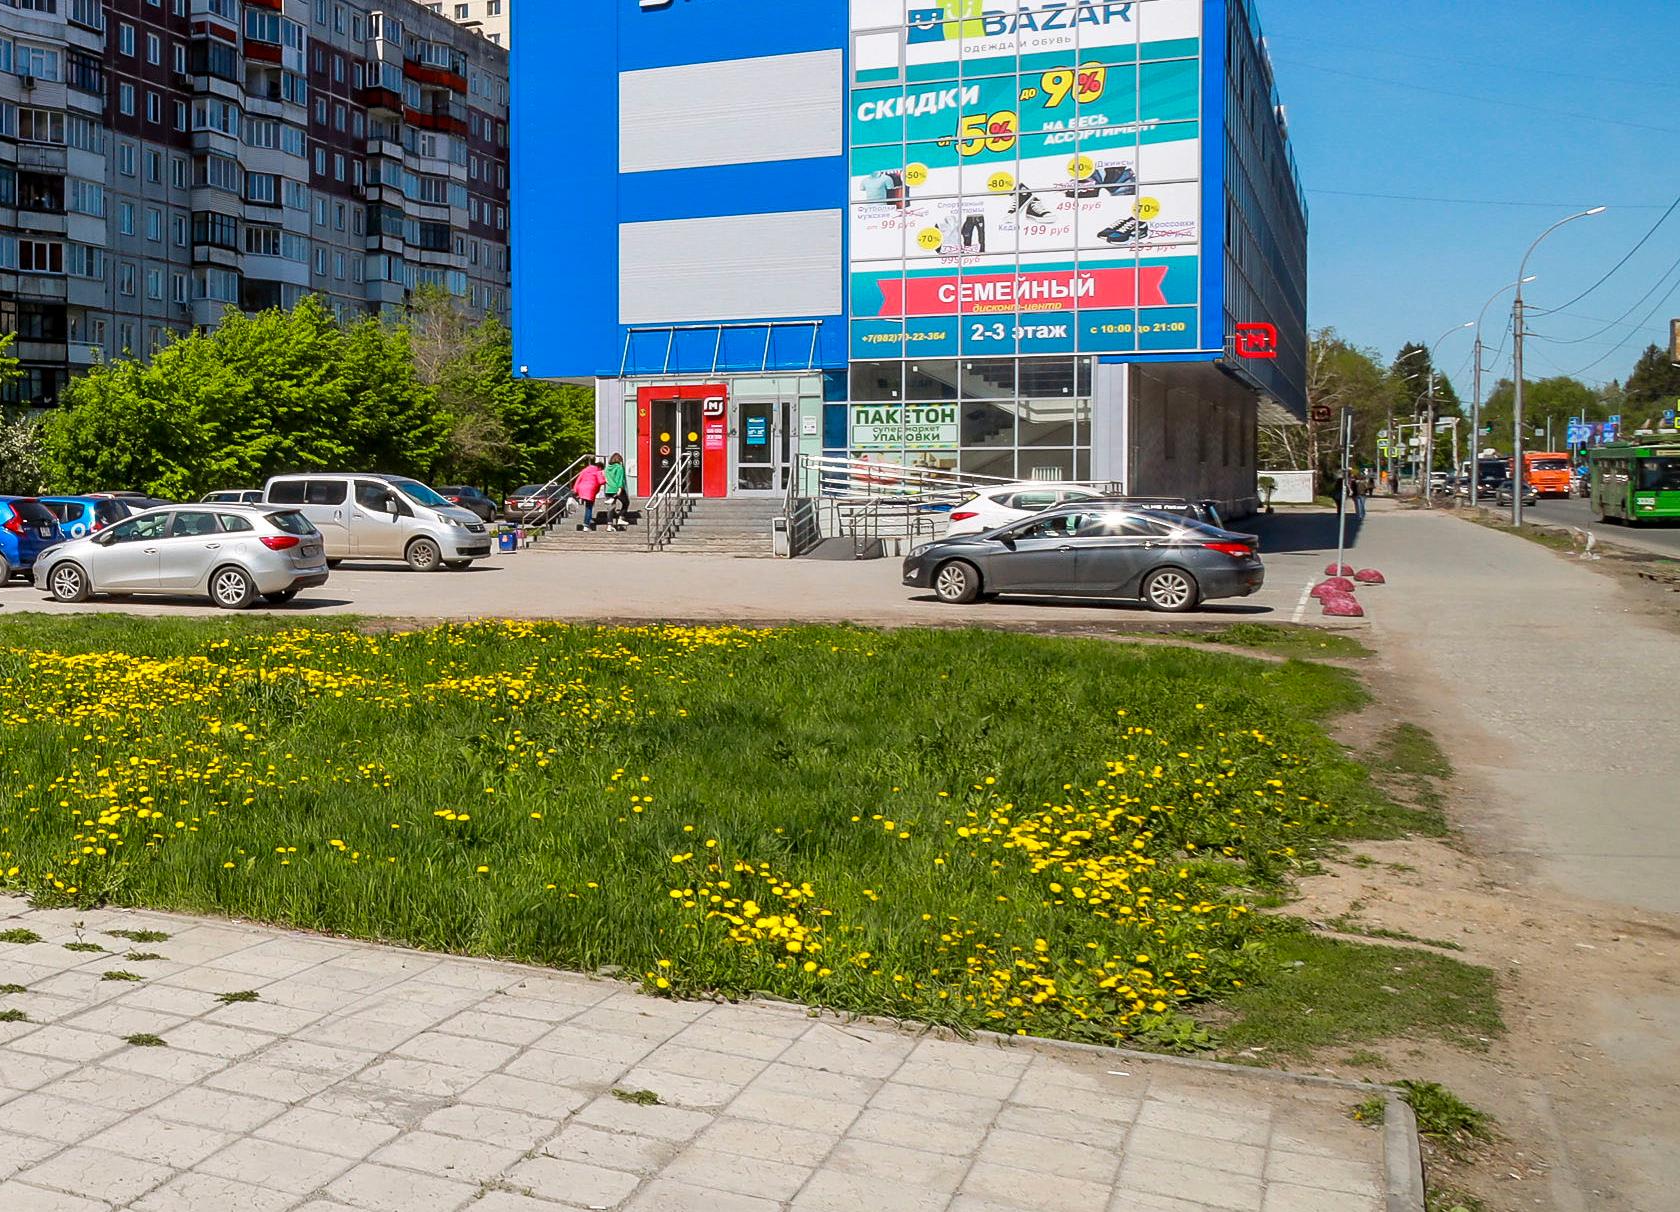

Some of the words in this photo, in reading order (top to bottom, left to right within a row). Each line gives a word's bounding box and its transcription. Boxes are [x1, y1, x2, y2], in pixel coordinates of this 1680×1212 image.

[981, 0, 1132, 37] BAZAR
[963, 42, 1015, 54] ОДЕЖДА
[1019, 40, 1027, 48] И
[1031, 36, 1072, 47] ОБУВЬ
[856, 85, 980, 121] СКИДКИ
[1042, 120, 1065, 131] НА
[1082, 201, 1102, 211] руб
[881, 220, 896, 230] 99
[1023, 225, 1047, 236] 199
[1049, 224, 1071, 237] руб
[937, 272, 1095, 303] СЕМЕЙНЫЙ
[970, 322, 1005, 341] 2-3
[1011, 324, 1068, 340] этаж
[1101, 324, 1132, 334] 10:00
[1153, 321, 1186, 333] 21:00
[855, 408, 955, 425] ПАКЕТОН
[872, 425, 940, 434] супермаркет
[872, 433, 941, 443] УПАКОВКИ
